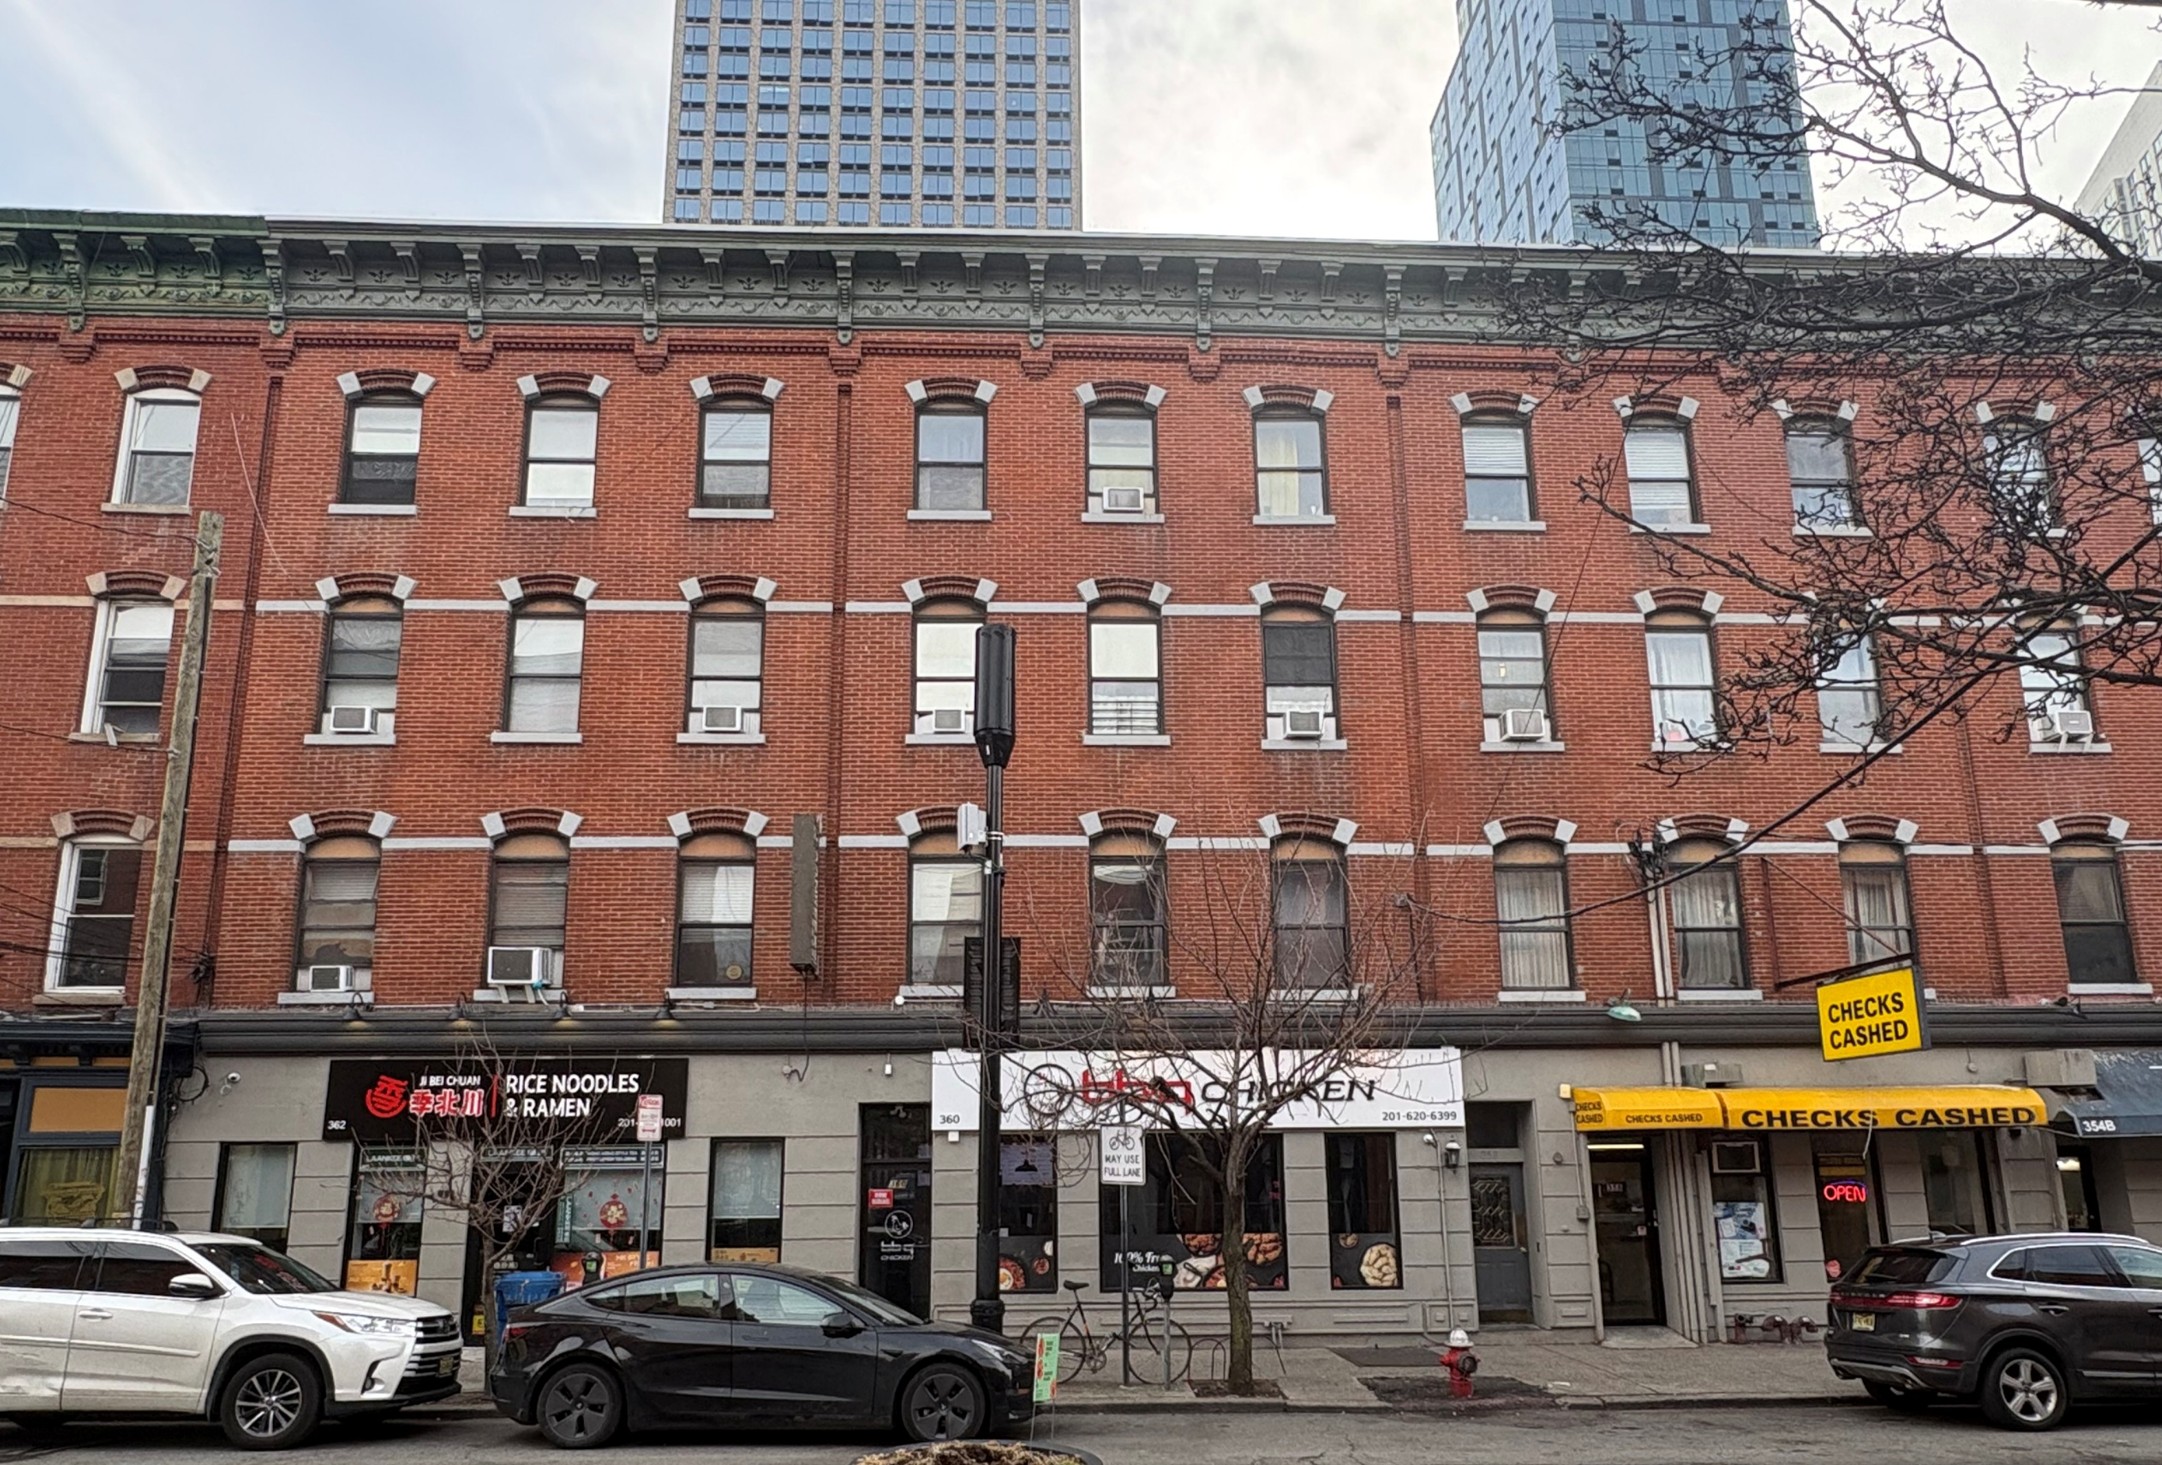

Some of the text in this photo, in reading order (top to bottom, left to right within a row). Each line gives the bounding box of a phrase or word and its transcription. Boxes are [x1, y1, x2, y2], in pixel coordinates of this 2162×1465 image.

[1828, 992, 1904, 1023] CHECKS
[1830, 1019, 1908, 1050] CASHED
[429, 1076, 444, 1086] BEI
[446, 1075, 481, 1086] CHUAN
[506, 1073, 640, 1094] RICE NOODLES
[410, 1089, 485, 1118] 季北川
[506, 1098, 591, 1118] & RAMEN
[1576, 1101, 1602, 1111] CHECKS
[939, 1114, 961, 1125] 360
[1382, 1111, 1457, 1121] 201-620-6399
[1576, 1113, 1603, 1124] CASHED
[1626, 1113, 1703, 1123] CHECKS CASHED
[1742, 1107, 2036, 1128] CHECKS CASHED
[327, 1120, 346, 1130] 362
[2082, 1119, 2116, 1132] 354B
[1105, 1154, 1140, 1164] MAY USE
[1104, 1167, 1141, 1178] FULL LANE
[1824, 1185, 1867, 1202] OPEN
